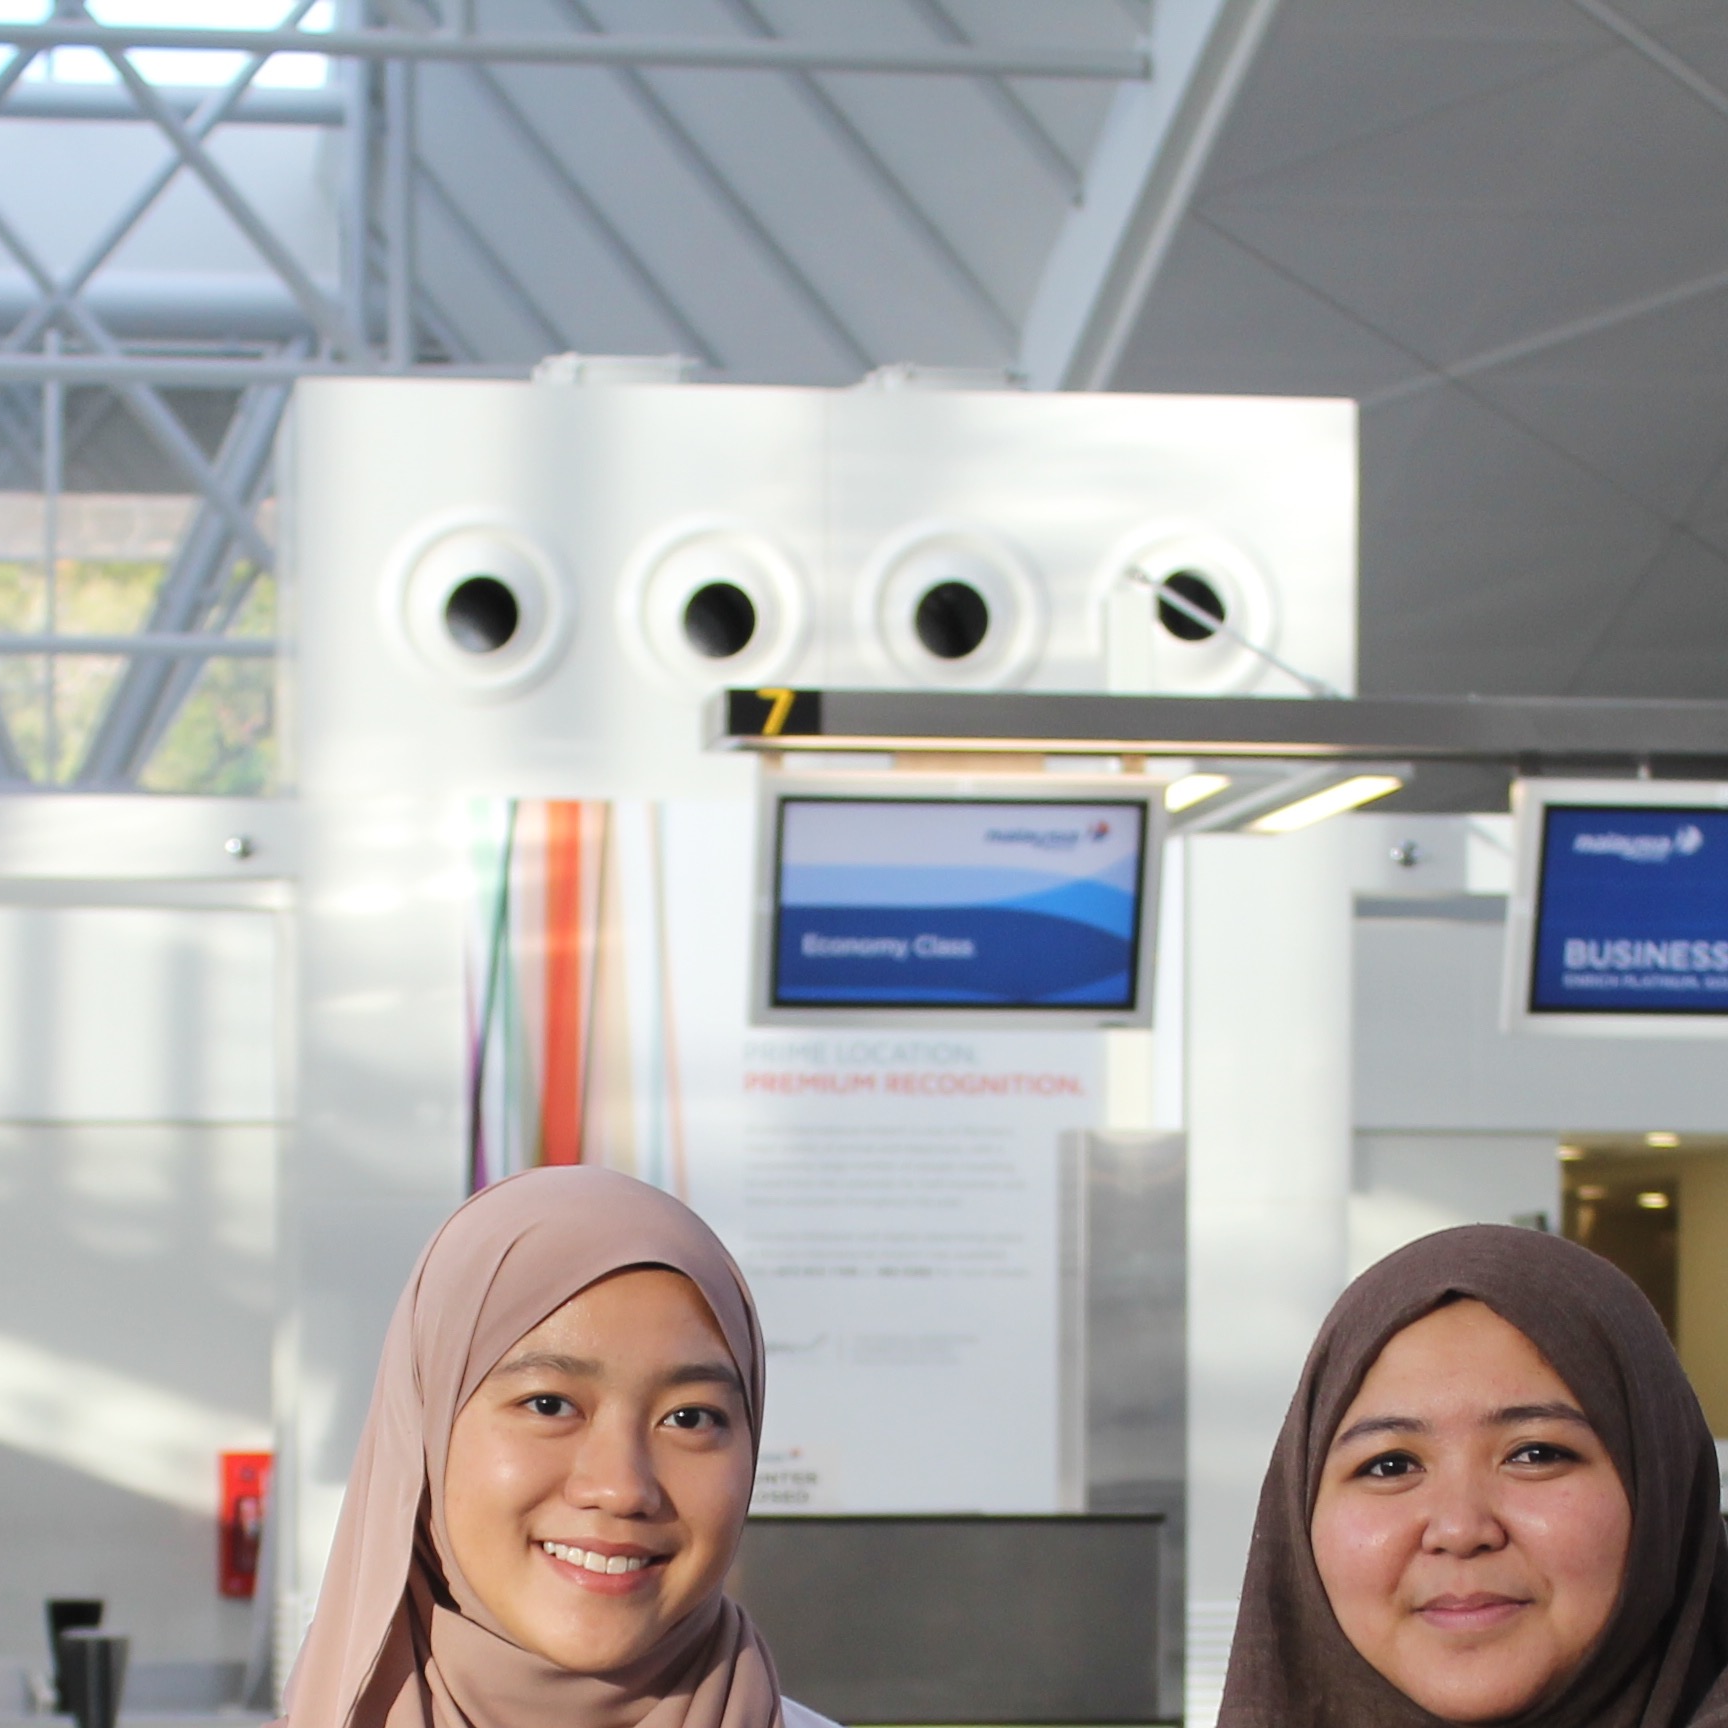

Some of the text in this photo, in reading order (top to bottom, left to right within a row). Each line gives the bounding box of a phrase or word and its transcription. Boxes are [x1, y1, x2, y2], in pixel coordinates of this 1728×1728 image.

[756, 688, 796, 735] 7
[802, 932, 975, 961] Economy Class
[744, 1070, 878, 1094] PREMIUM
